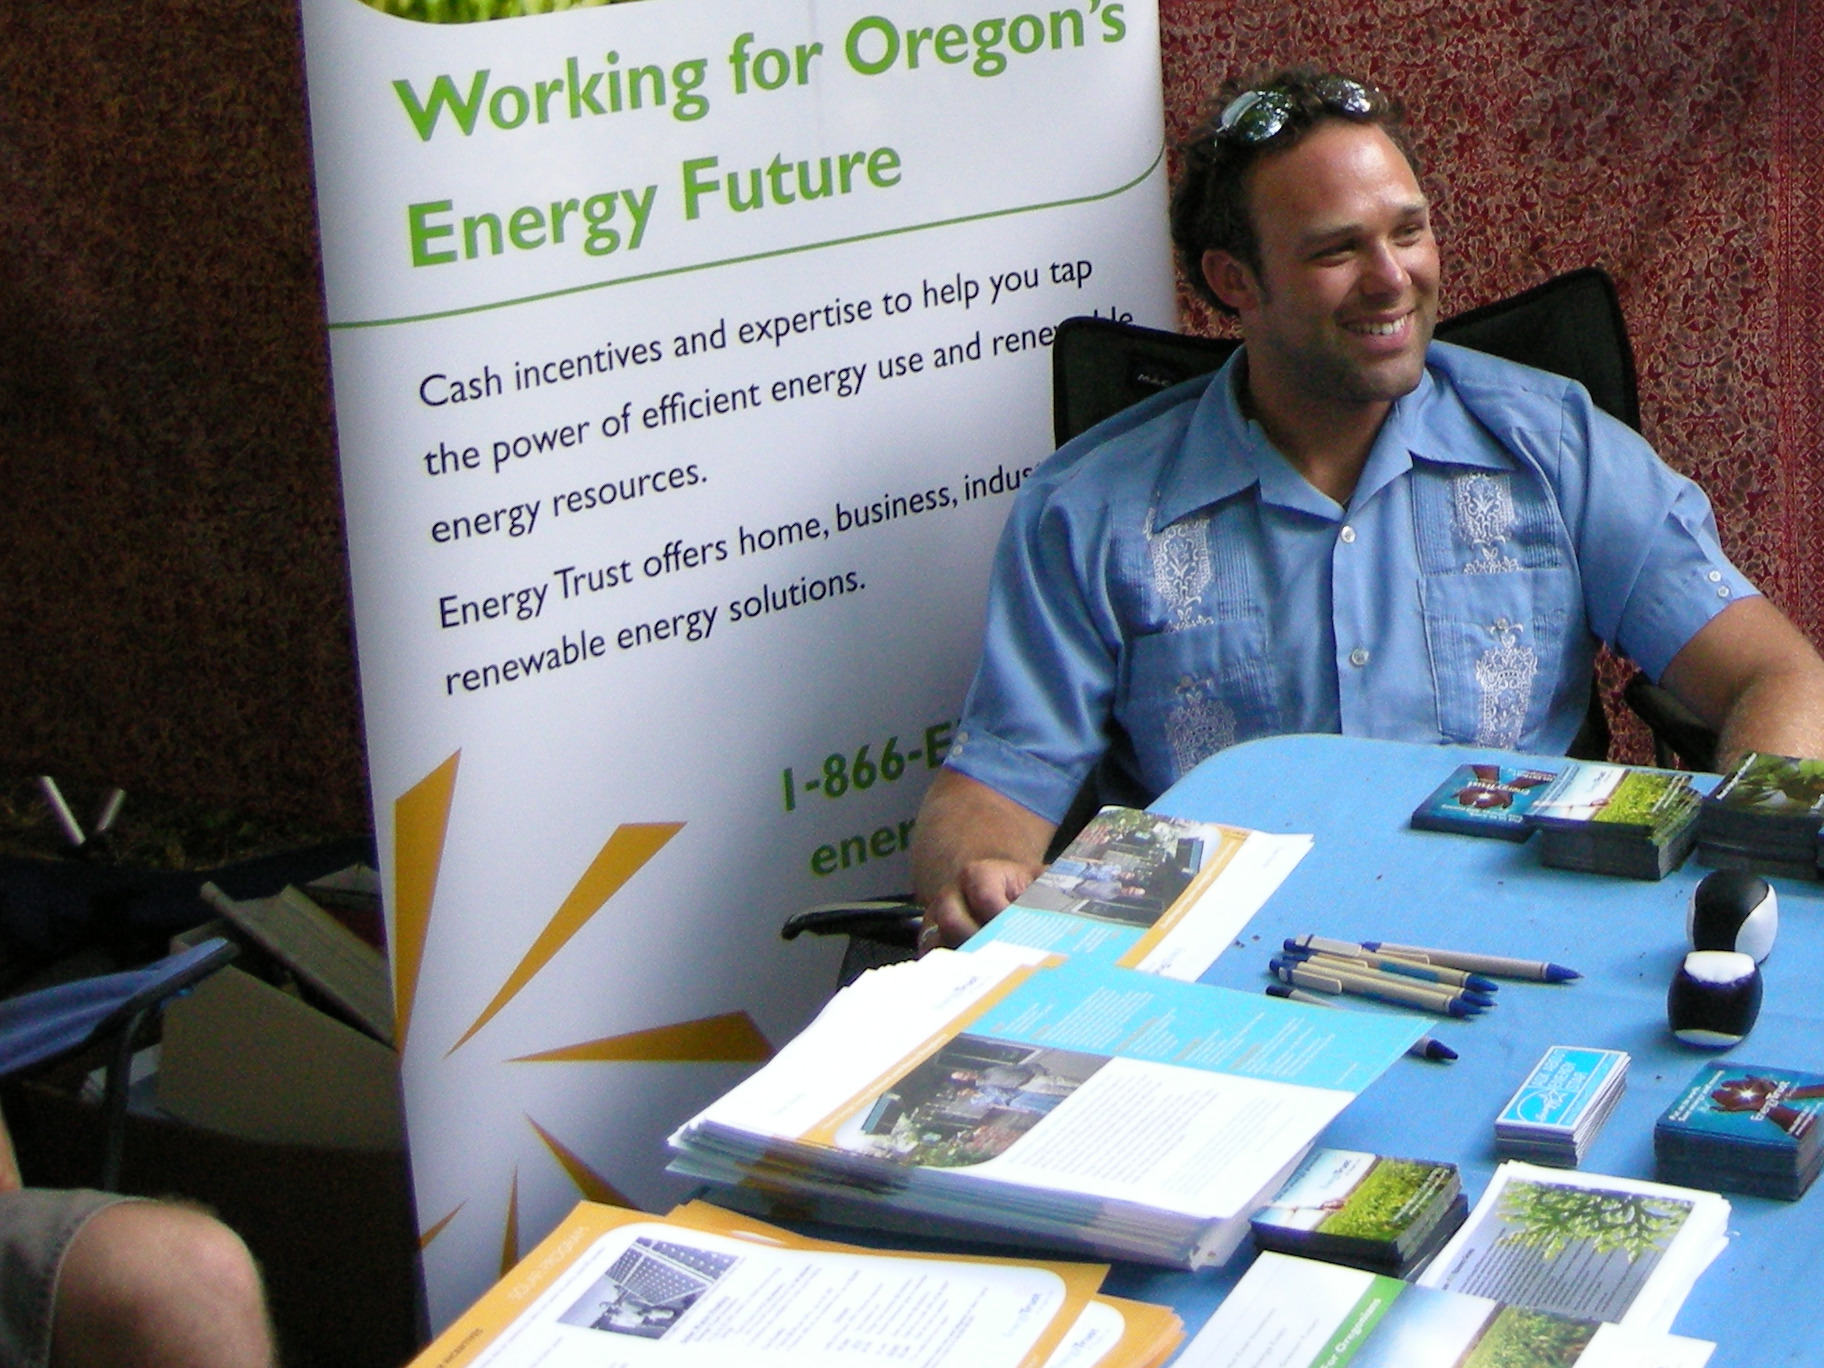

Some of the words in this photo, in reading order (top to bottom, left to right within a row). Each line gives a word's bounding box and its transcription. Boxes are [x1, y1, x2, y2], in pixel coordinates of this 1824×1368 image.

[390, 51, 710, 142] Working
[727, 33, 824, 94] for
[405, 185, 658, 268] Energy
[681, 147, 901, 221] Future
[419, 365, 502, 407] Cash
[515, 340, 662, 390] incentives
[674, 318, 726, 357] and
[739, 298, 872, 347] expertise
[882, 293, 912, 316] to
[923, 273, 979, 309] help
[989, 268, 1039, 305] you
[1049, 256, 1092, 289] tap
[423, 442, 480, 476] the
[493, 422, 590, 474] power
[602, 402, 632, 438] of
[642, 384, 761, 429] efficient
[771, 363, 867, 402] energy
[878, 353, 923, 380] use
[934, 331, 981, 368] and
[431, 500, 540, 543] energy
[553, 464, 707, 517] resources.
[439, 584, 548, 629] Energy
[553, 560, 633, 599] Trust
[643, 540, 728, 577] offers
[739, 518, 829, 556] home,
[836, 487, 958, 532] business,
[446, 630, 605, 696] renewable
[617, 606, 718, 650] energy
[729, 573, 867, 623] solutions.
[783, 719, 962, 812] 1-866-E
[811, 819, 916, 877] ener
